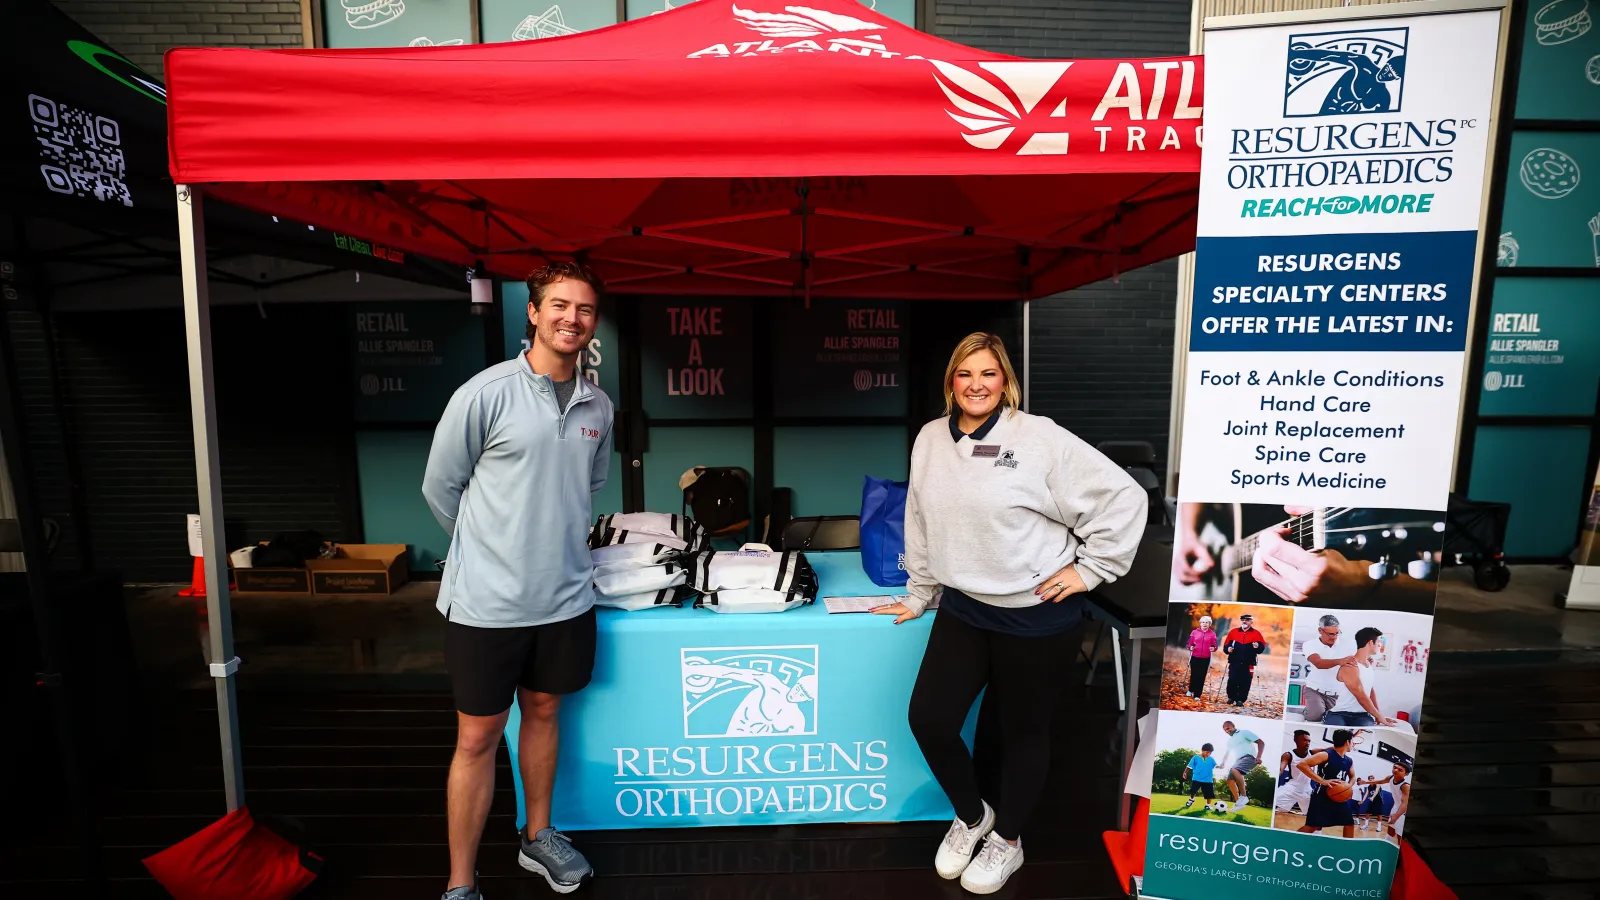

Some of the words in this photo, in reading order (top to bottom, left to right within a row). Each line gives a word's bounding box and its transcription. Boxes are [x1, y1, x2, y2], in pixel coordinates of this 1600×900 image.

[1229, 119, 1457, 154] RESURGENS
[1460, 118, 1477, 128] PC
[1227, 156, 1453, 189] ORTHOPAEDICS
[1240, 196, 1325, 218] REACH
[1328, 197, 1355, 213] for
[1358, 193, 1435, 214] MORE
[1257, 252, 1401, 273] RESURGENS
[1212, 284, 1334, 304] SPECIALTY
[1340, 283, 1447, 302] CENTERS
[356, 312, 409, 333] RETAIL
[667, 307, 723, 336] TAKE
[847, 308, 899, 329] RETAIL
[1201, 316, 1269, 334] OFFER
[1275, 316, 1320, 333] THE
[1327, 315, 1408, 333] LATEST
[1415, 315, 1454, 333] IN:
[1492, 312, 1541, 333] RETAIL
[358, 340, 384, 353] ALLIE
[385, 339, 434, 353] SPANGLER
[688, 338, 703, 365] A
[824, 336, 849, 349] ALLIE
[852, 336, 899, 349] SPANGLER
[1489, 339, 1515, 352] ALLIE
[1515, 339, 1560, 352] SPANGLER
[667, 368, 725, 396] LOOK
[873, 373, 899, 387] JLL
[1200, 370, 1241, 386] Foot
[1247, 370, 1261, 386] &
[1266, 369, 1326, 387] Ankle
[1333, 369, 1444, 388] Conditions
[1502, 374, 1526, 388] JLL
[1259, 395, 1315, 412] Hand
[1323, 396, 1371, 413] Care
[1223, 420, 1268, 436] Joint
[1275, 421, 1405, 441] Replacement
[1255, 445, 1311, 465] Spine
[1318, 447, 1367, 464] Care
[1230, 469, 1290, 488] Sports
[1296, 471, 1387, 489] Medicine
[612, 740, 888, 777] RESURGENS
[615, 782, 887, 817] ORTHOPAEDICS
[1159, 832, 1383, 875] resurgens.com
[1154, 860, 1207, 875] GEORGIA'S
[1210, 867, 1253, 882] LARGEST
[1256, 875, 1332, 894] ORTHOPAEDIC
[1335, 887, 1382, 898] PRACTICE
